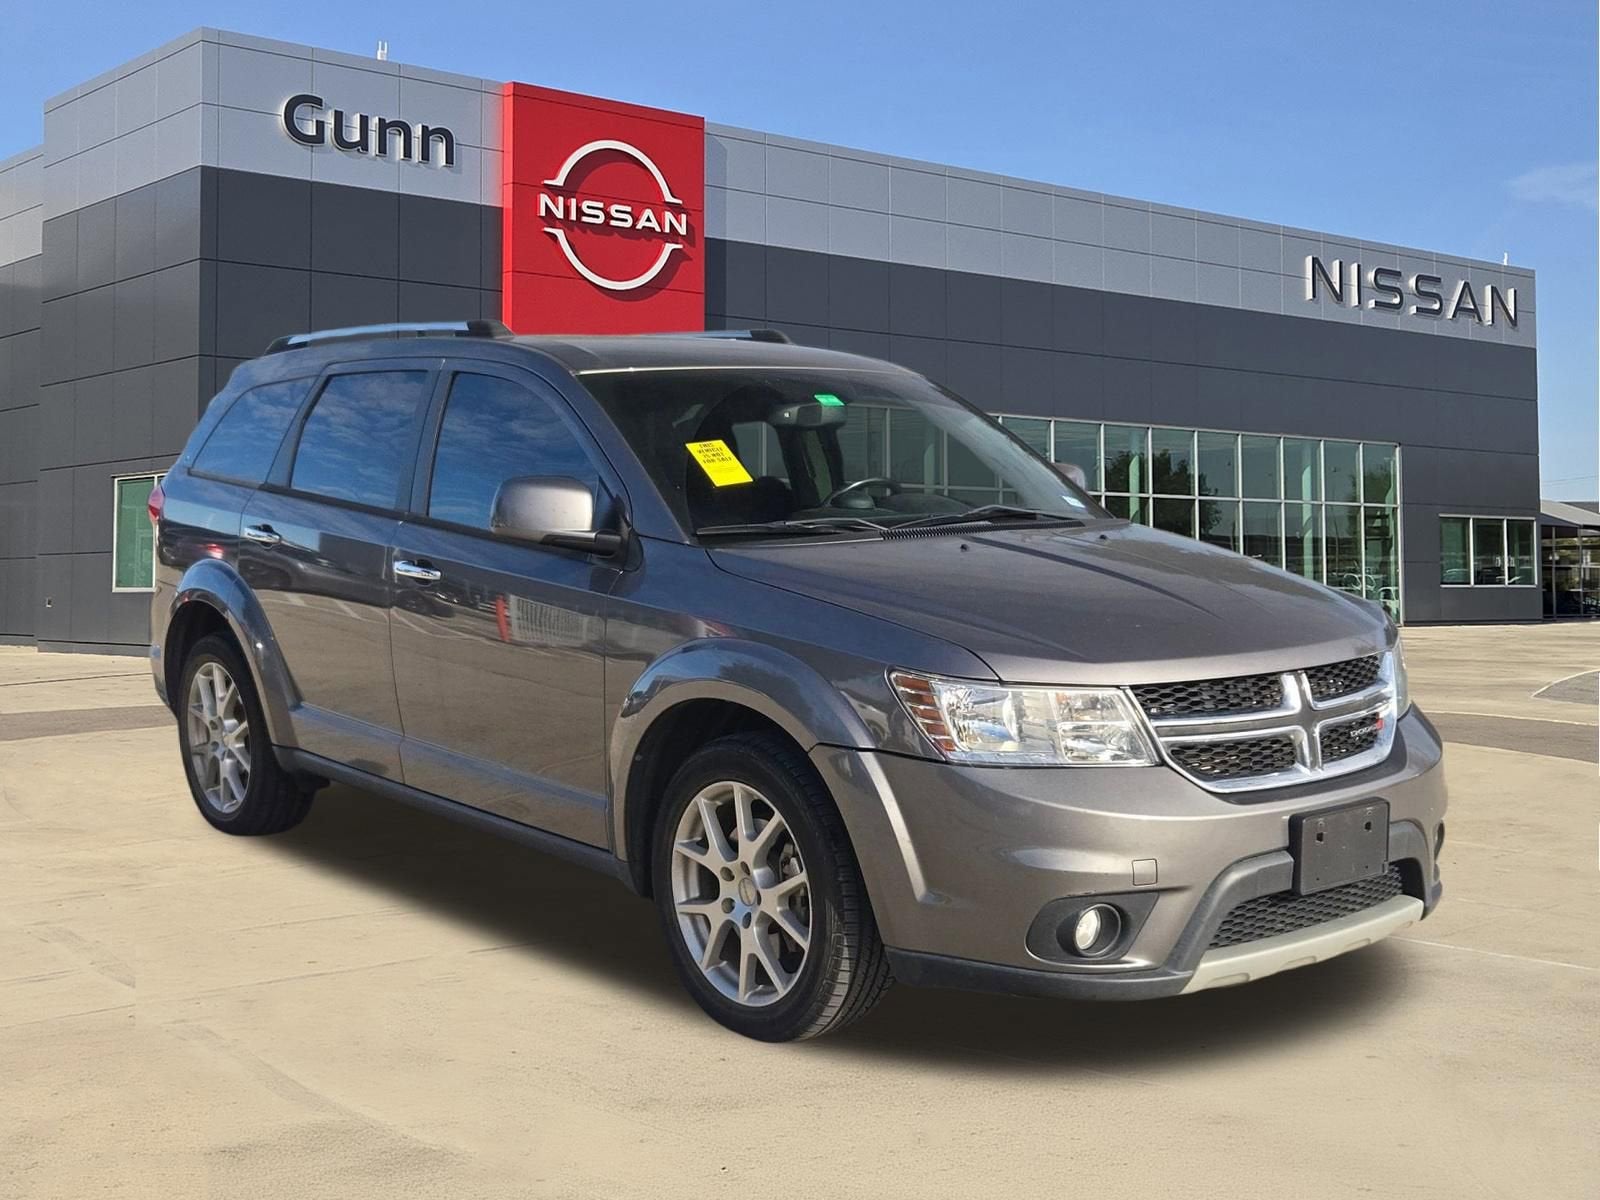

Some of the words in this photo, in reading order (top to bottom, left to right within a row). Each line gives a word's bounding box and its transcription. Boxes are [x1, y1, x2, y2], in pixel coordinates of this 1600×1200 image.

[282, 94, 455, 168] Gunn
[538, 193, 688, 236] NISSAN
[1305, 255, 1518, 328] NISSAN
[1350, 724, 1376, 737] DOD
